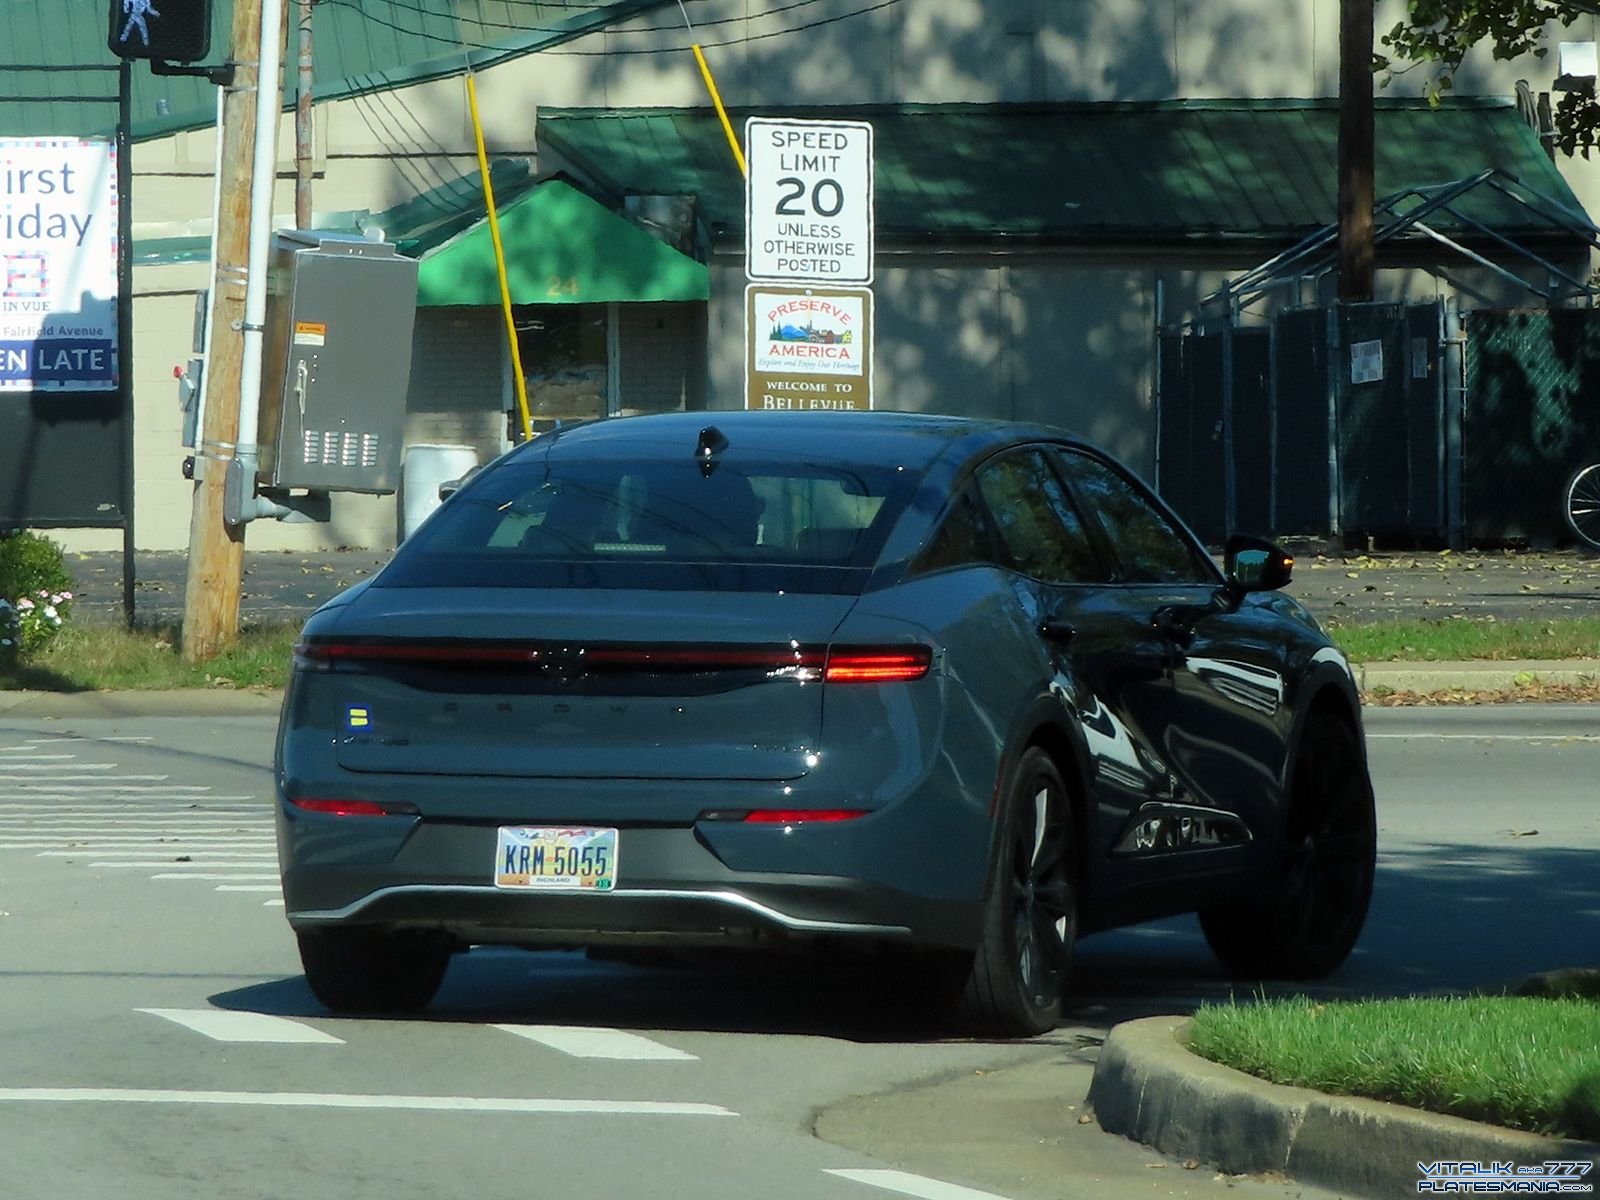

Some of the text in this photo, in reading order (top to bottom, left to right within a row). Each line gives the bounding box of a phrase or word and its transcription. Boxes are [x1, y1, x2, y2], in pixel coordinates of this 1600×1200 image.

[771, 130, 849, 150] SPEED
[780, 153, 841, 172] LIMIT
[0, 160, 76, 194] irst
[775, 177, 844, 217] 20
[0, 203, 93, 247] iday
[777, 223, 841, 239] UNLESS
[763, 240, 855, 256] OTHERWISE
[777, 258, 841, 273] POSTED
[547, 276, 578, 296] 24
[3, 302, 51, 311] IN VUE
[768, 300, 852, 326] PRESERVE
[3, 325, 104, 337] Fairfield Avenue
[38, 349, 105, 371] LATE
[768, 344, 850, 359] AMERICA
[766, 381, 853, 393] WELCOME TO
[505, 844, 608, 876] KRM 5055
